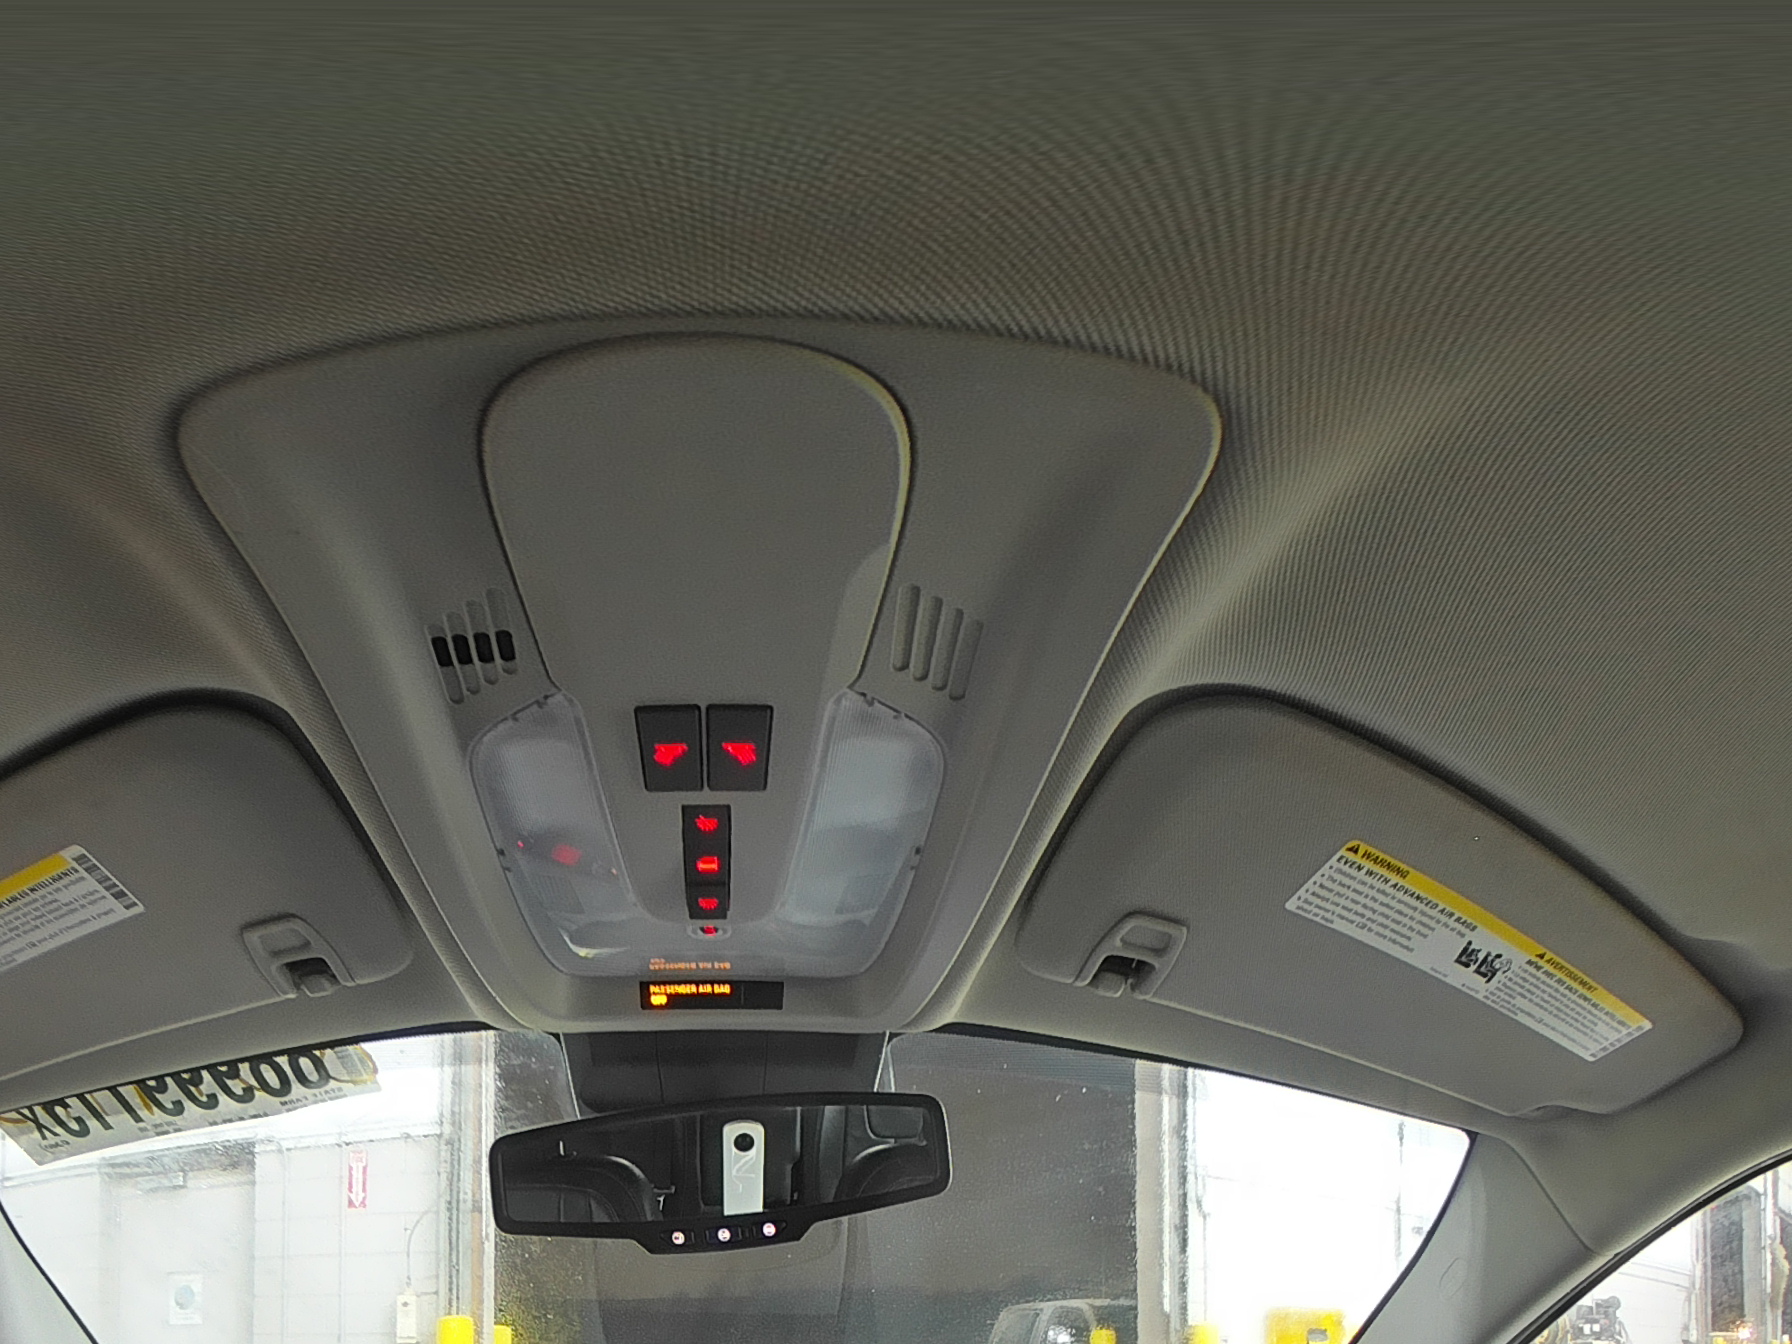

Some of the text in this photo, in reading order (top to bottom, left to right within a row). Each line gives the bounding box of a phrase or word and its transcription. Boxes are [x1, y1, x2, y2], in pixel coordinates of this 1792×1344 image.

[1360, 849, 1410, 880] WARNING
[1337, 854, 1363, 873] EVEN
[1364, 867, 1392, 886] WITH
[1391, 881, 1440, 910] ADVANCED
[1440, 906, 1457, 920] AIR
[1457, 914, 1478, 933] BAGS
[649, 984, 731, 994] PASSENGER AIR BAG
[1545, 957, 1599, 993] AVERTISSEMENT
